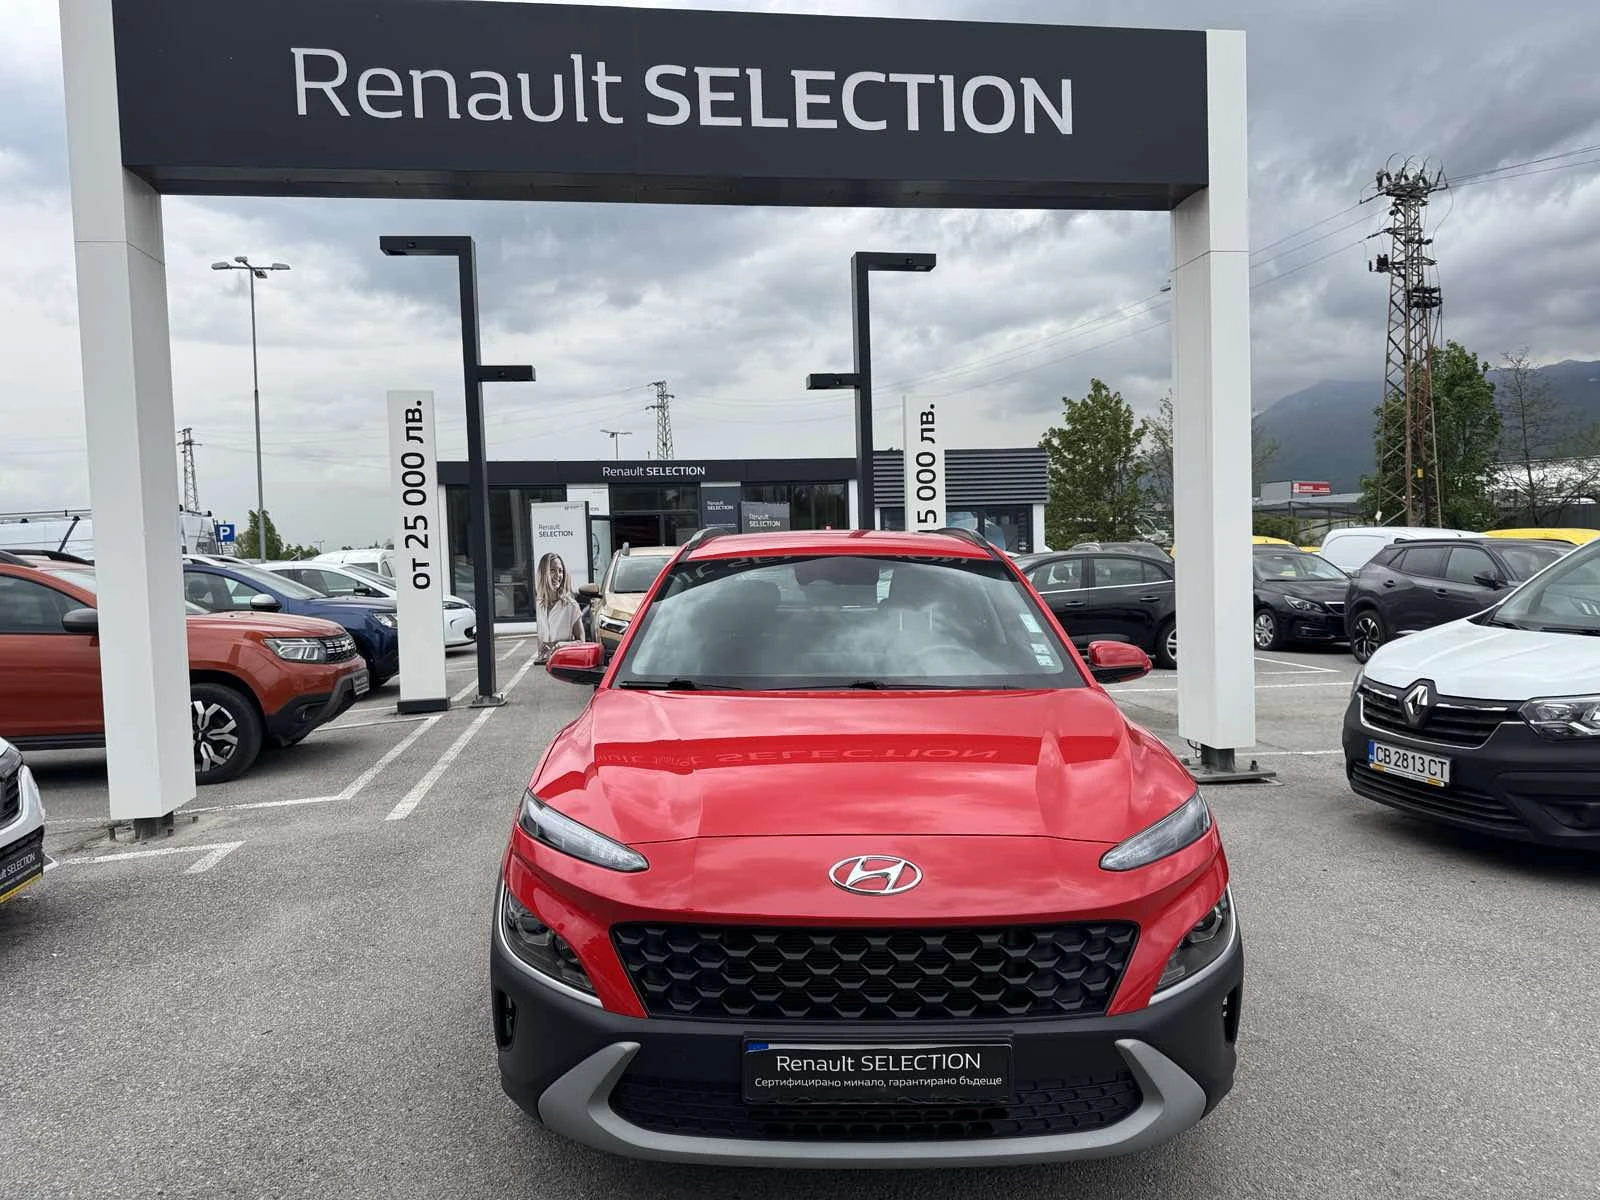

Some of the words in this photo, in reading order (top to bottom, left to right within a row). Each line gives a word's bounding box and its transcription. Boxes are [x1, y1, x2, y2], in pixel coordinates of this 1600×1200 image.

[290, 47, 624, 126] Renault
[644, 64, 1073, 135] SELECTION
[405, 400, 424, 444] лв.
[920, 403, 936, 444] лв.
[401, 452, 427, 506] 000
[602, 466, 644, 477] Renault
[646, 466, 706, 476] SELECTION
[916, 451, 937, 502] 000
[219, 526, 231, 541] P
[404, 515, 429, 549] 25
[538, 530, 574, 538] SELECTION
[749, 520, 781, 528] SELECTION
[917, 509, 938, 532] 5
[412, 558, 431, 590] от
[1375, 746, 1392, 765] CB
[1394, 751, 1426, 774] 2813
[1428, 759, 1448, 778] CT
[6, 852, 36, 876] SELECTION
[776, 1055, 855, 1072] Renault
[860, 1053, 981, 1071] SELECTION
[754, 1077, 842, 1088] Сертифицирано
[843, 1078, 887, 1088] минало,
[888, 1077, 957, 1088] гарантирано
[958, 1075, 1003, 1087] бъдеще
